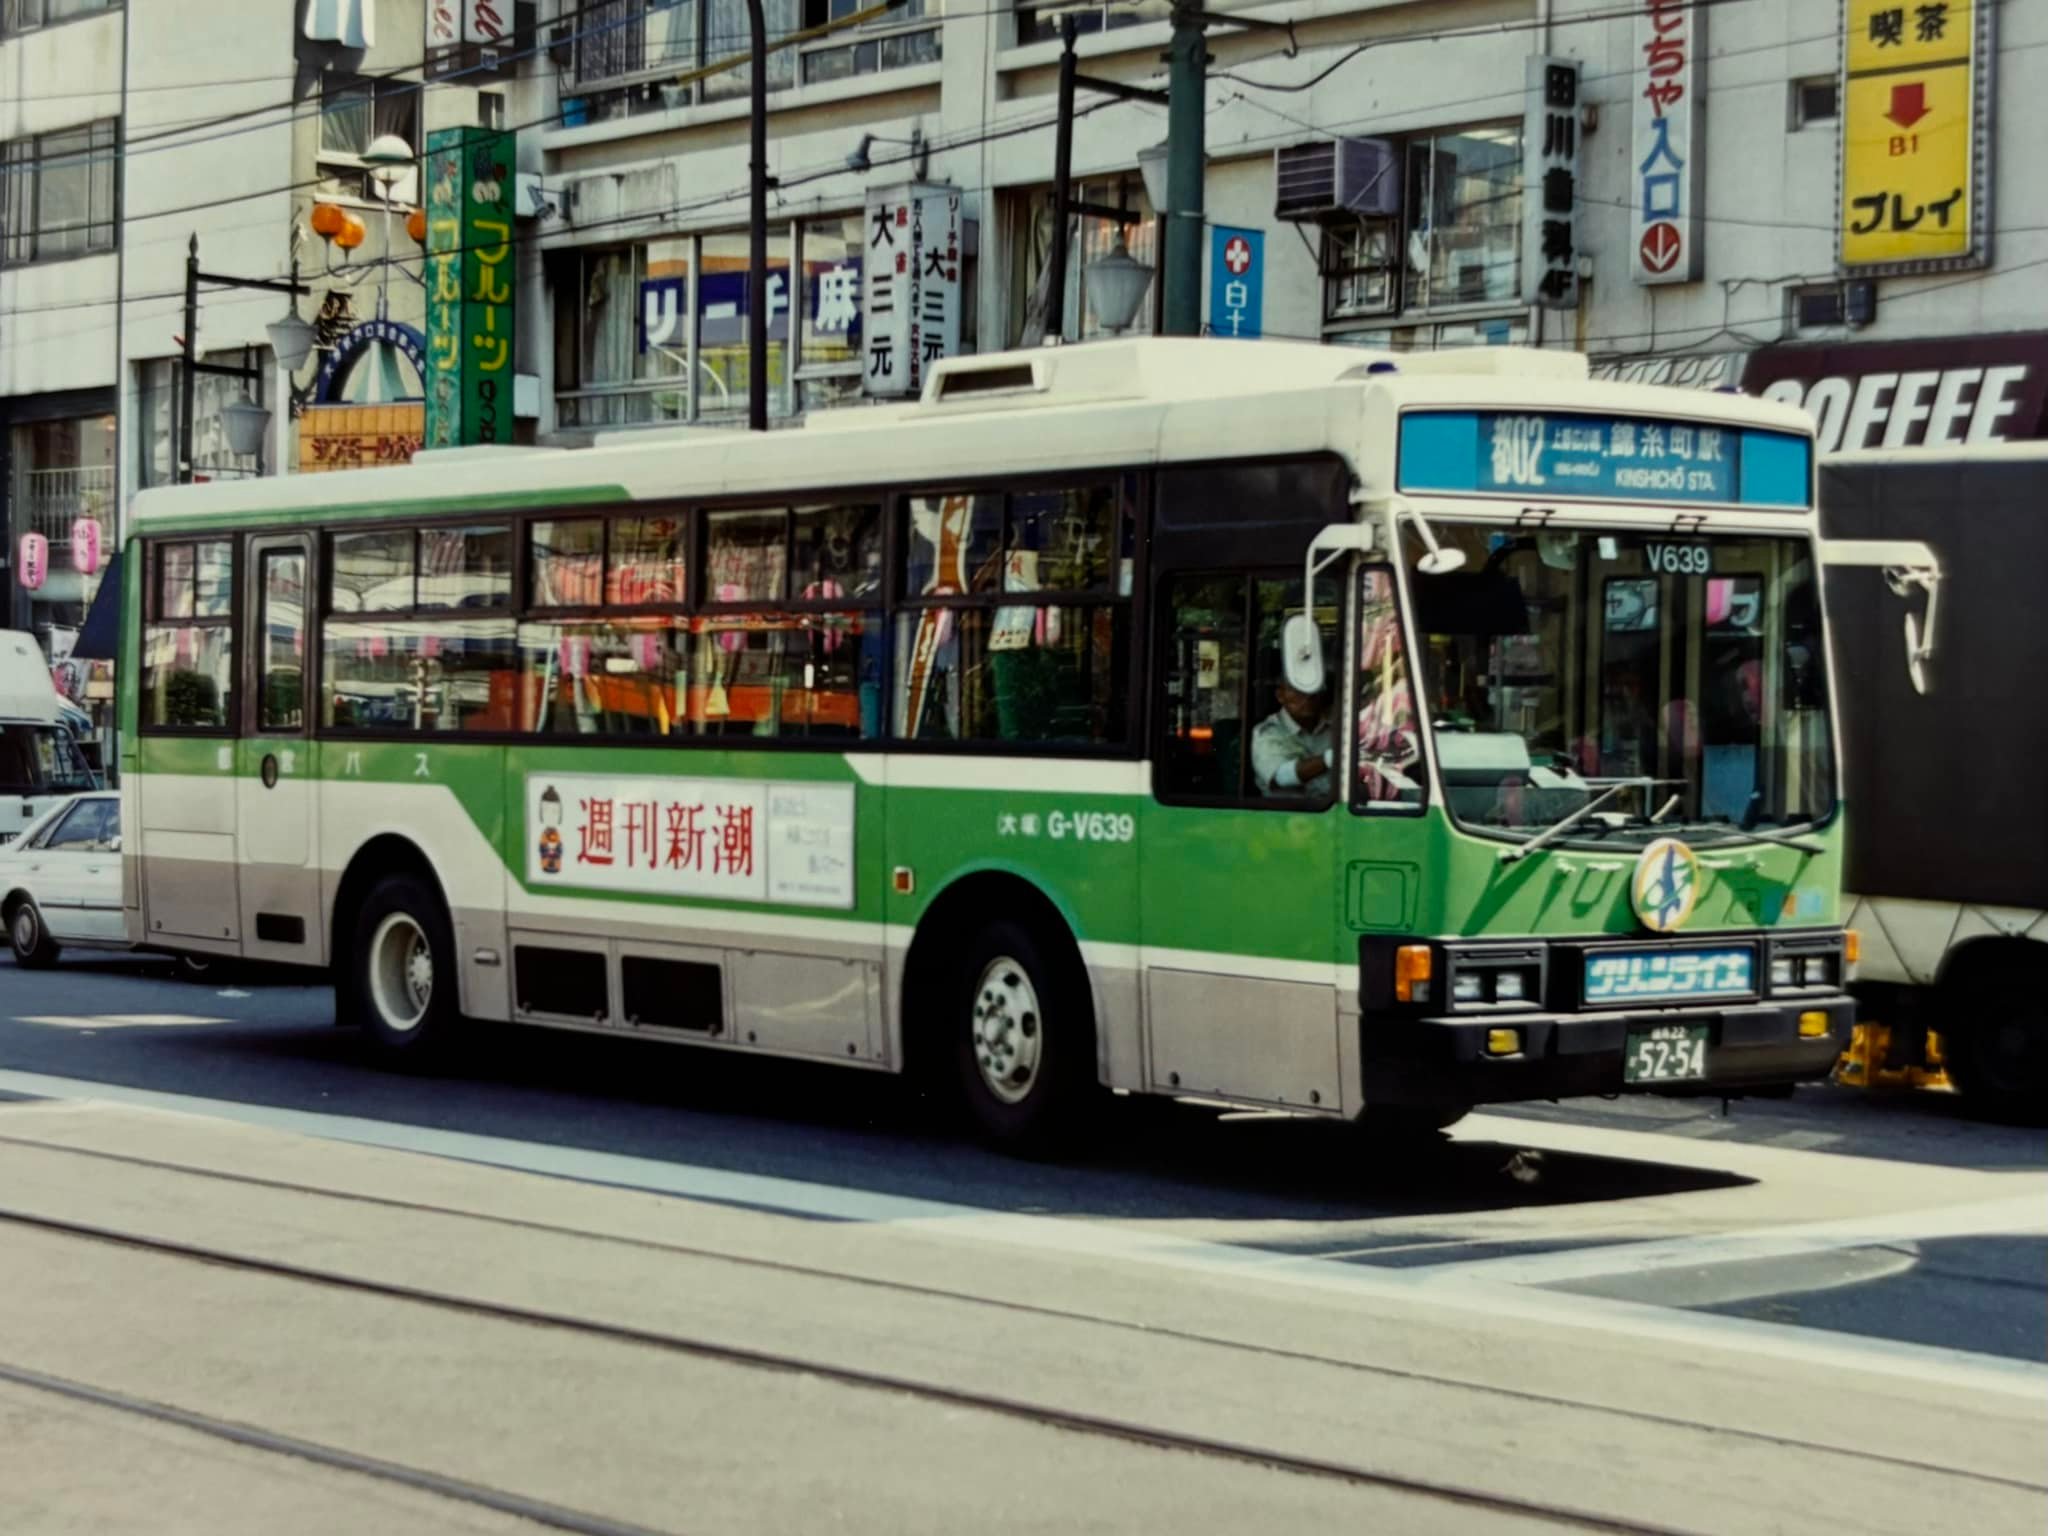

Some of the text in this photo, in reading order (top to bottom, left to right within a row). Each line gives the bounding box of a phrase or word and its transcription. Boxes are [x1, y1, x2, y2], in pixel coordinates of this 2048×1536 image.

[1889, 133, 1918, 157] B1
[871, 203, 895, 378] 大三元
[1646, 543, 1710, 573] V639
[577, 796, 754, 877] 週刊新潮
[1047, 809, 1135, 842] G-V639
